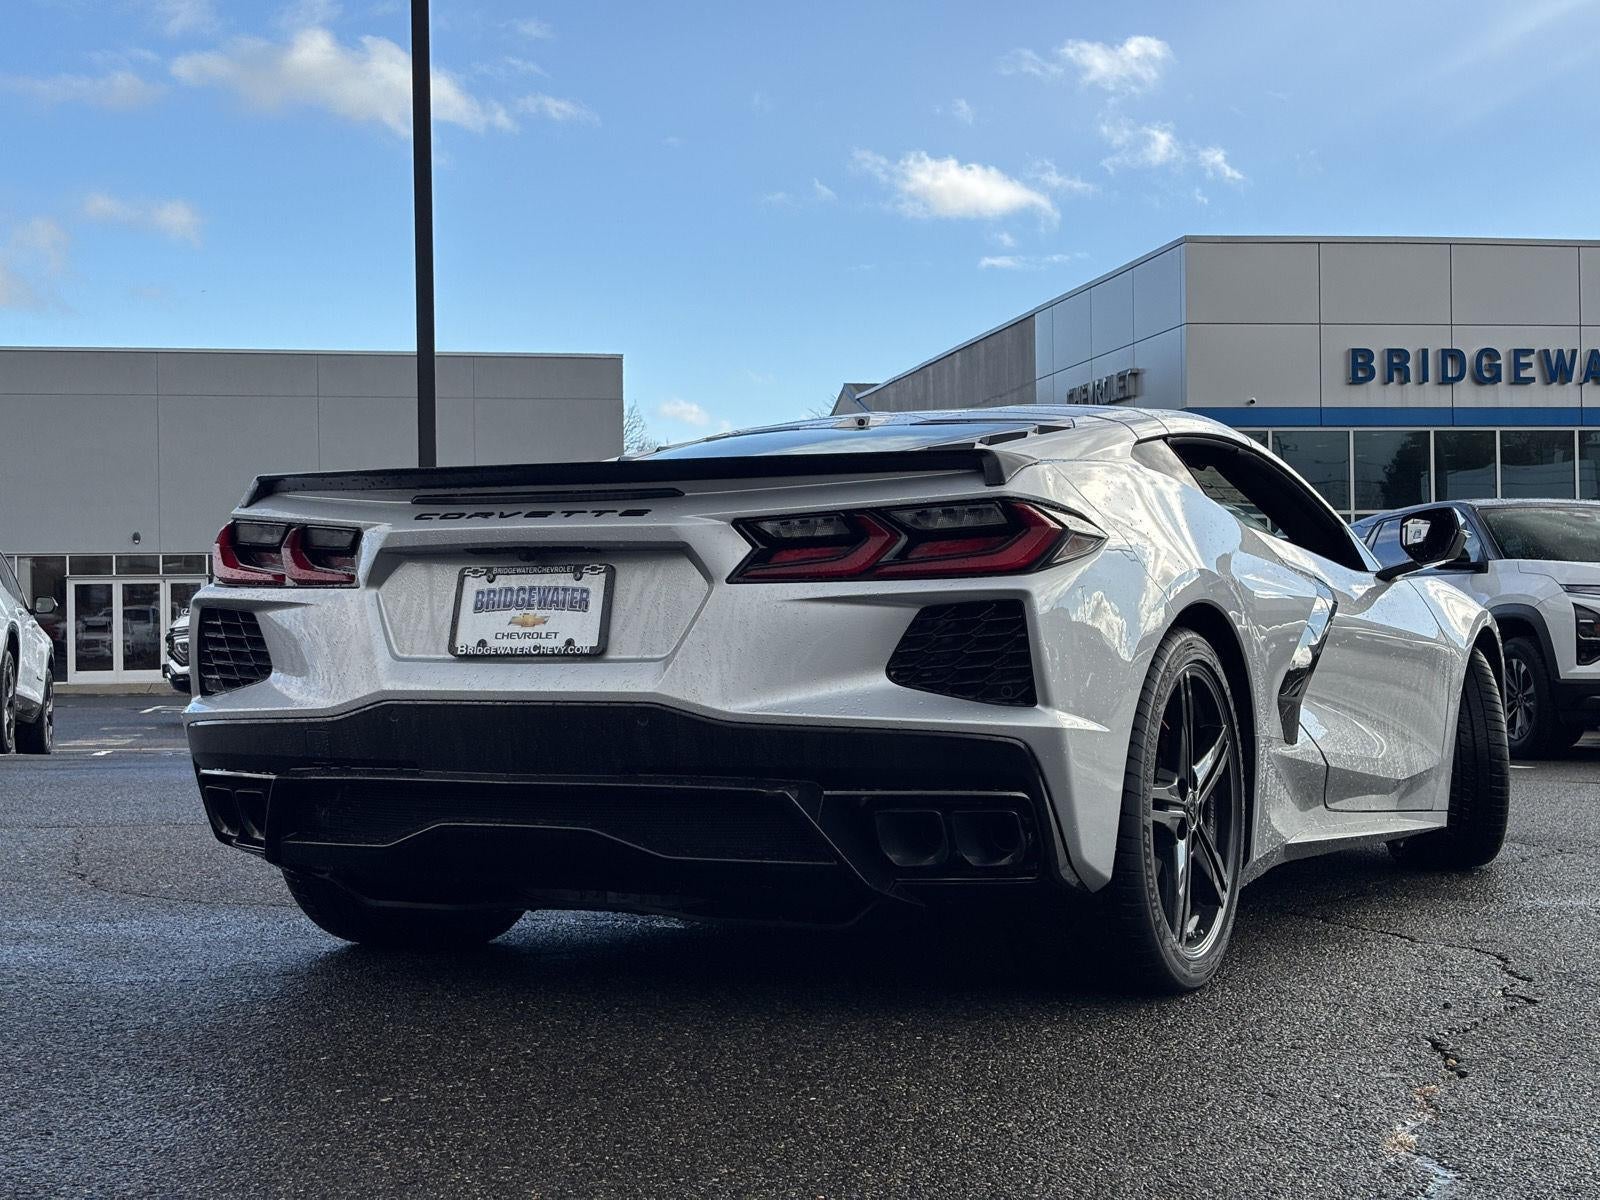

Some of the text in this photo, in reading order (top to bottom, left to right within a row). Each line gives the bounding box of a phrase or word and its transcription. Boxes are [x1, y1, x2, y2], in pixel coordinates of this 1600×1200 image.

[1347, 347, 1600, 385] BRIDGEWA
[414, 509, 651, 520] CORVETTE
[473, 585, 590, 613] BRIDGEWATER
[494, 631, 559, 640] CHEVROLET
[457, 644, 590, 655] BRIDGEWATERCHEVY.COM
